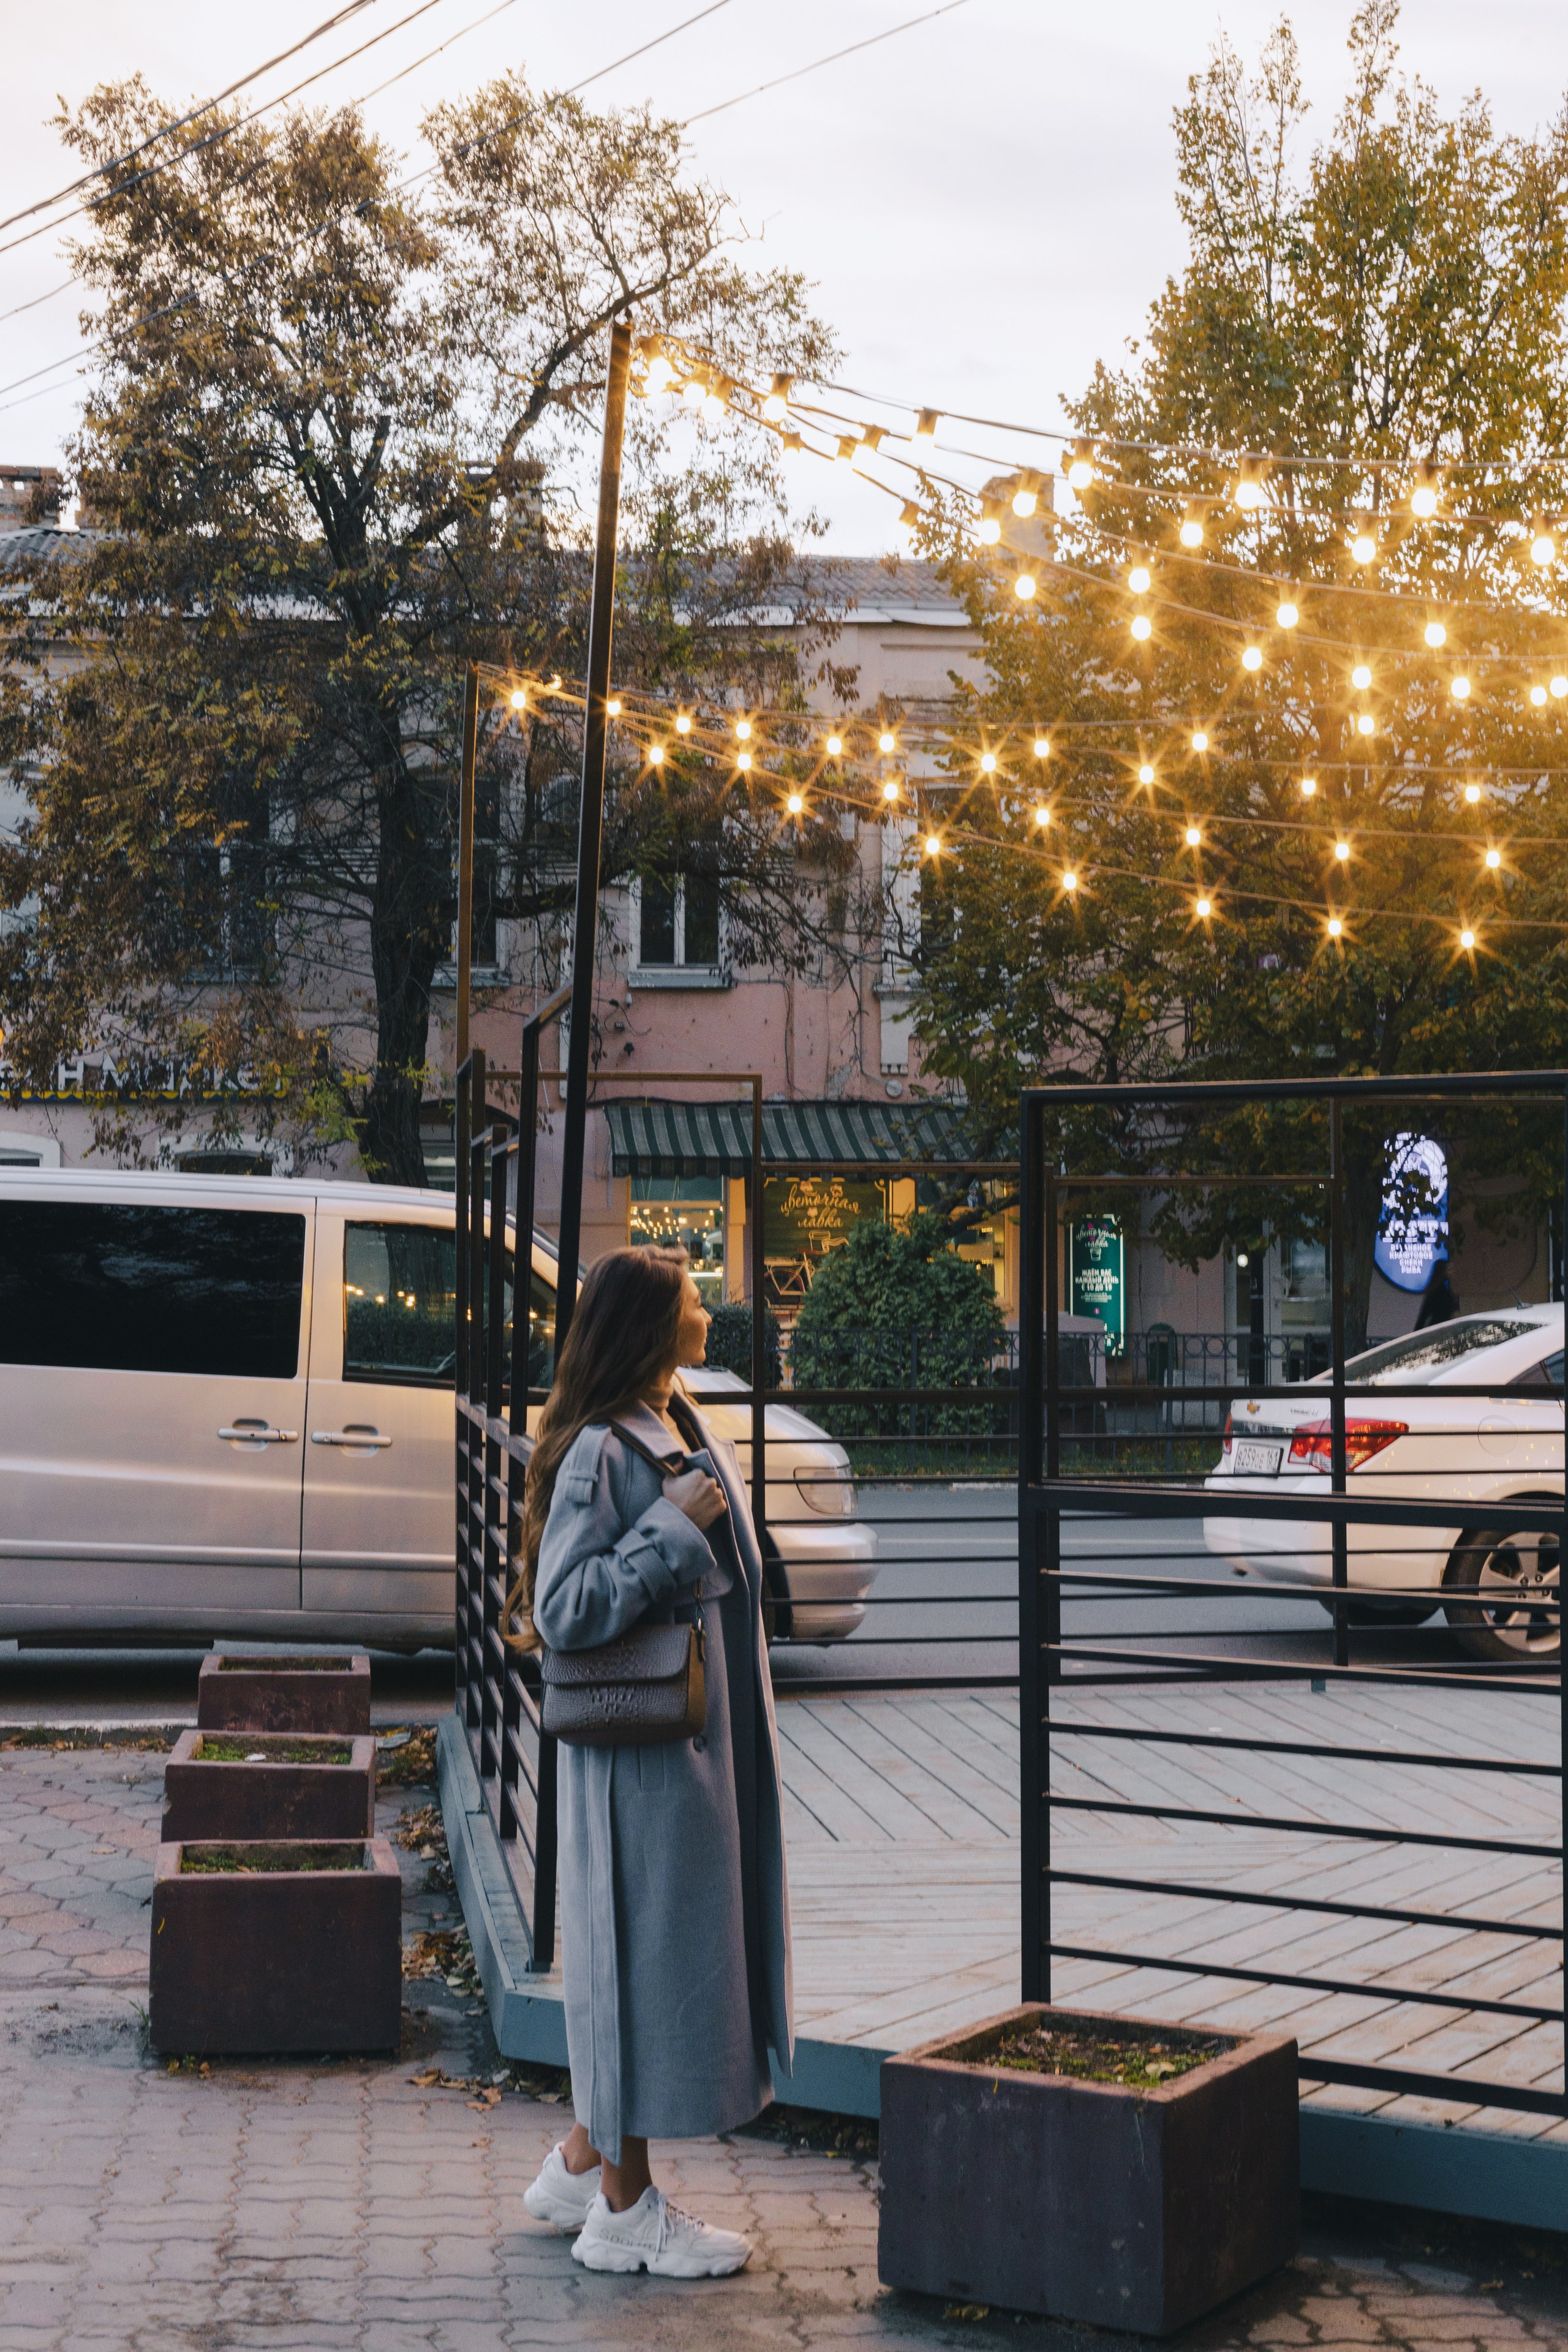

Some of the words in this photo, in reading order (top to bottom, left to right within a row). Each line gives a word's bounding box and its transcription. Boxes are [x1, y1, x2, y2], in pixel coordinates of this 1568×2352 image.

[798, 1206, 843, 1227] лавка
[1103, 1276, 1119, 1284] ДЕНЬ
[1095, 1283, 1104, 1292] ДО
